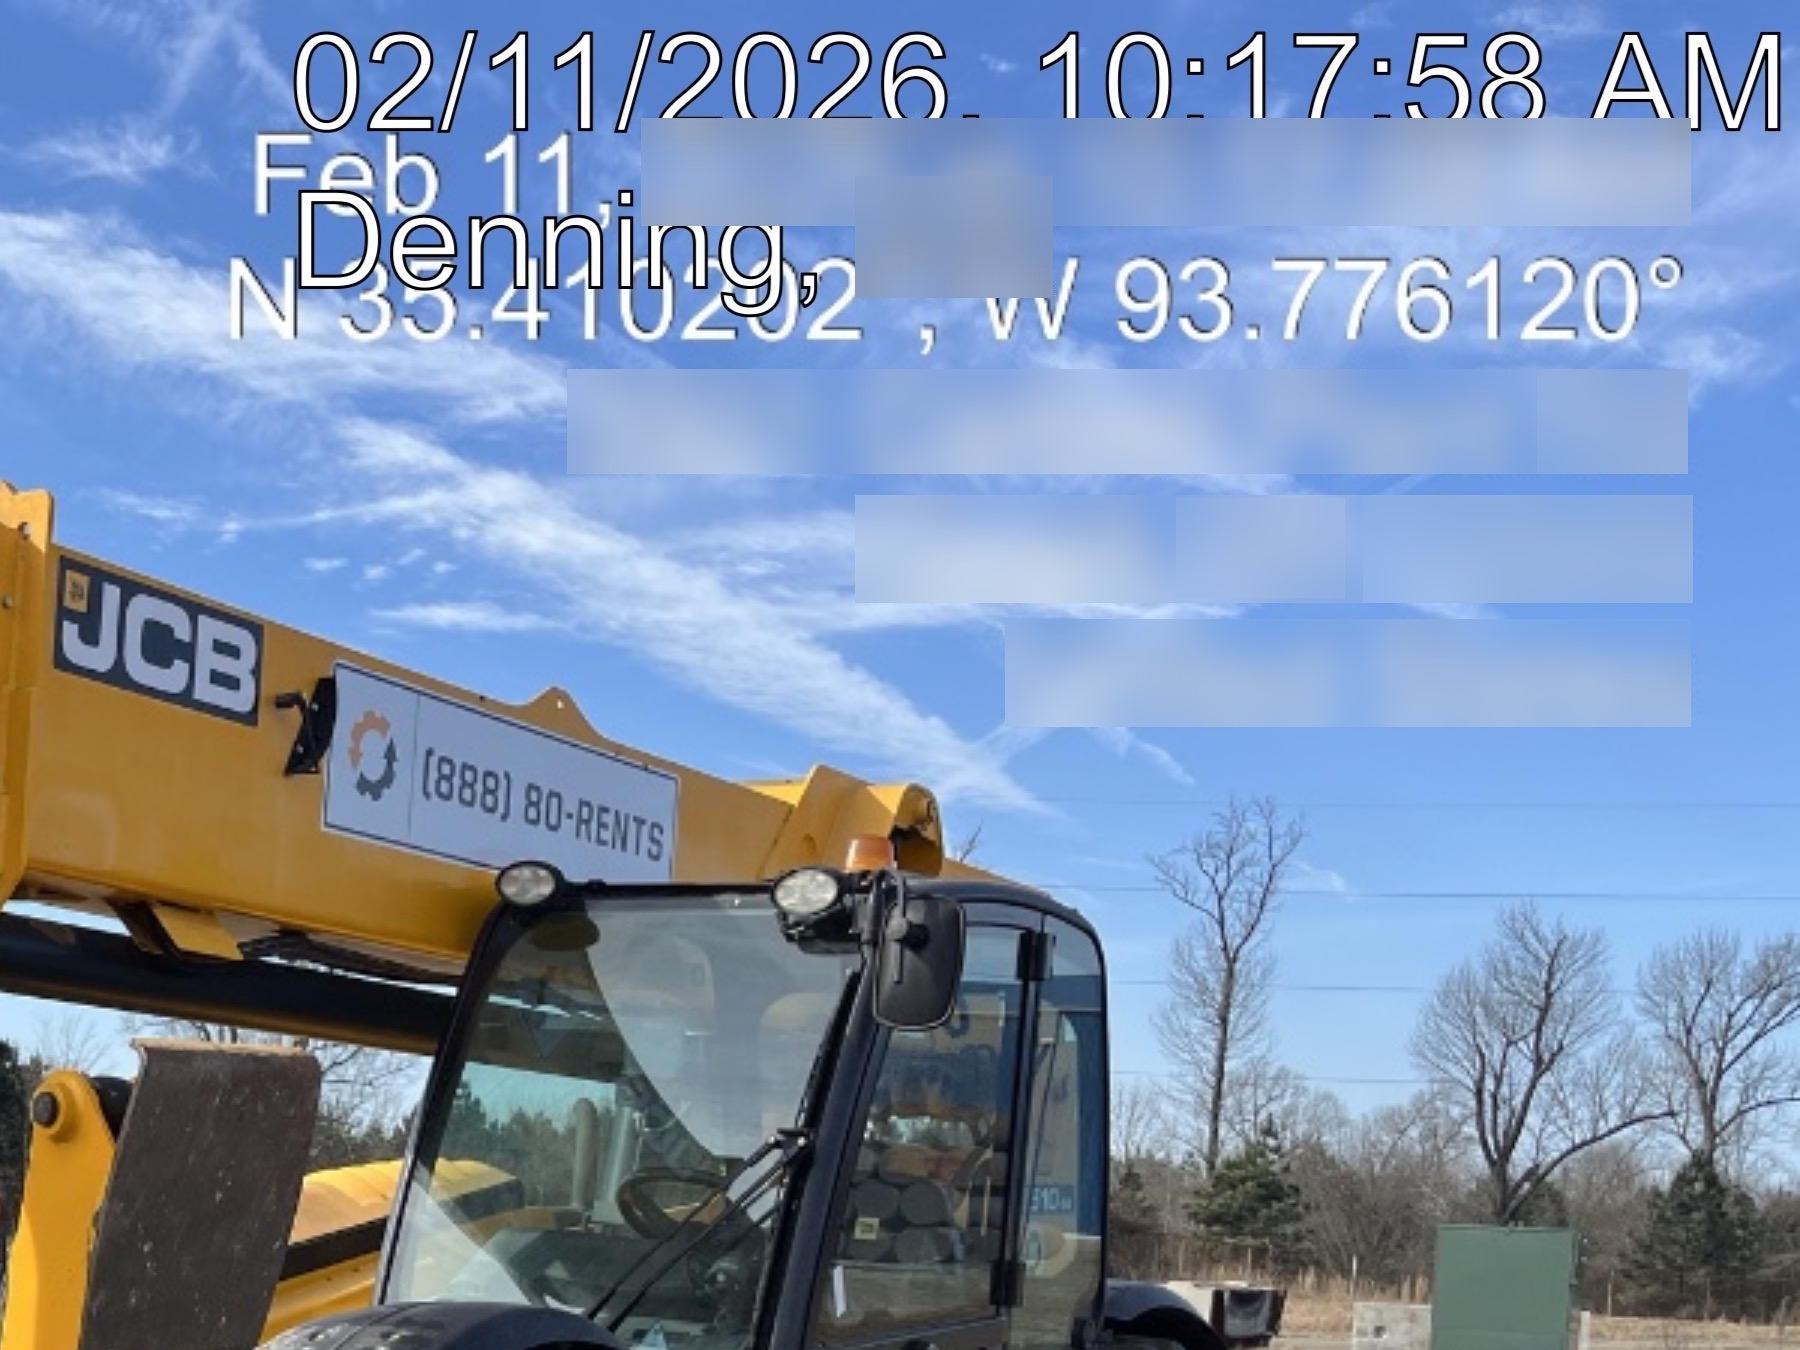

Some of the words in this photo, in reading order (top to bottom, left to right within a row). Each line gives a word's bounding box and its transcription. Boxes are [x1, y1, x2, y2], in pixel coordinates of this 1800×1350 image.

[61, 582, 257, 713] JCB
[422, 747, 512, 822] (888)
[524, 783, 665, 862] 80-RENTS
